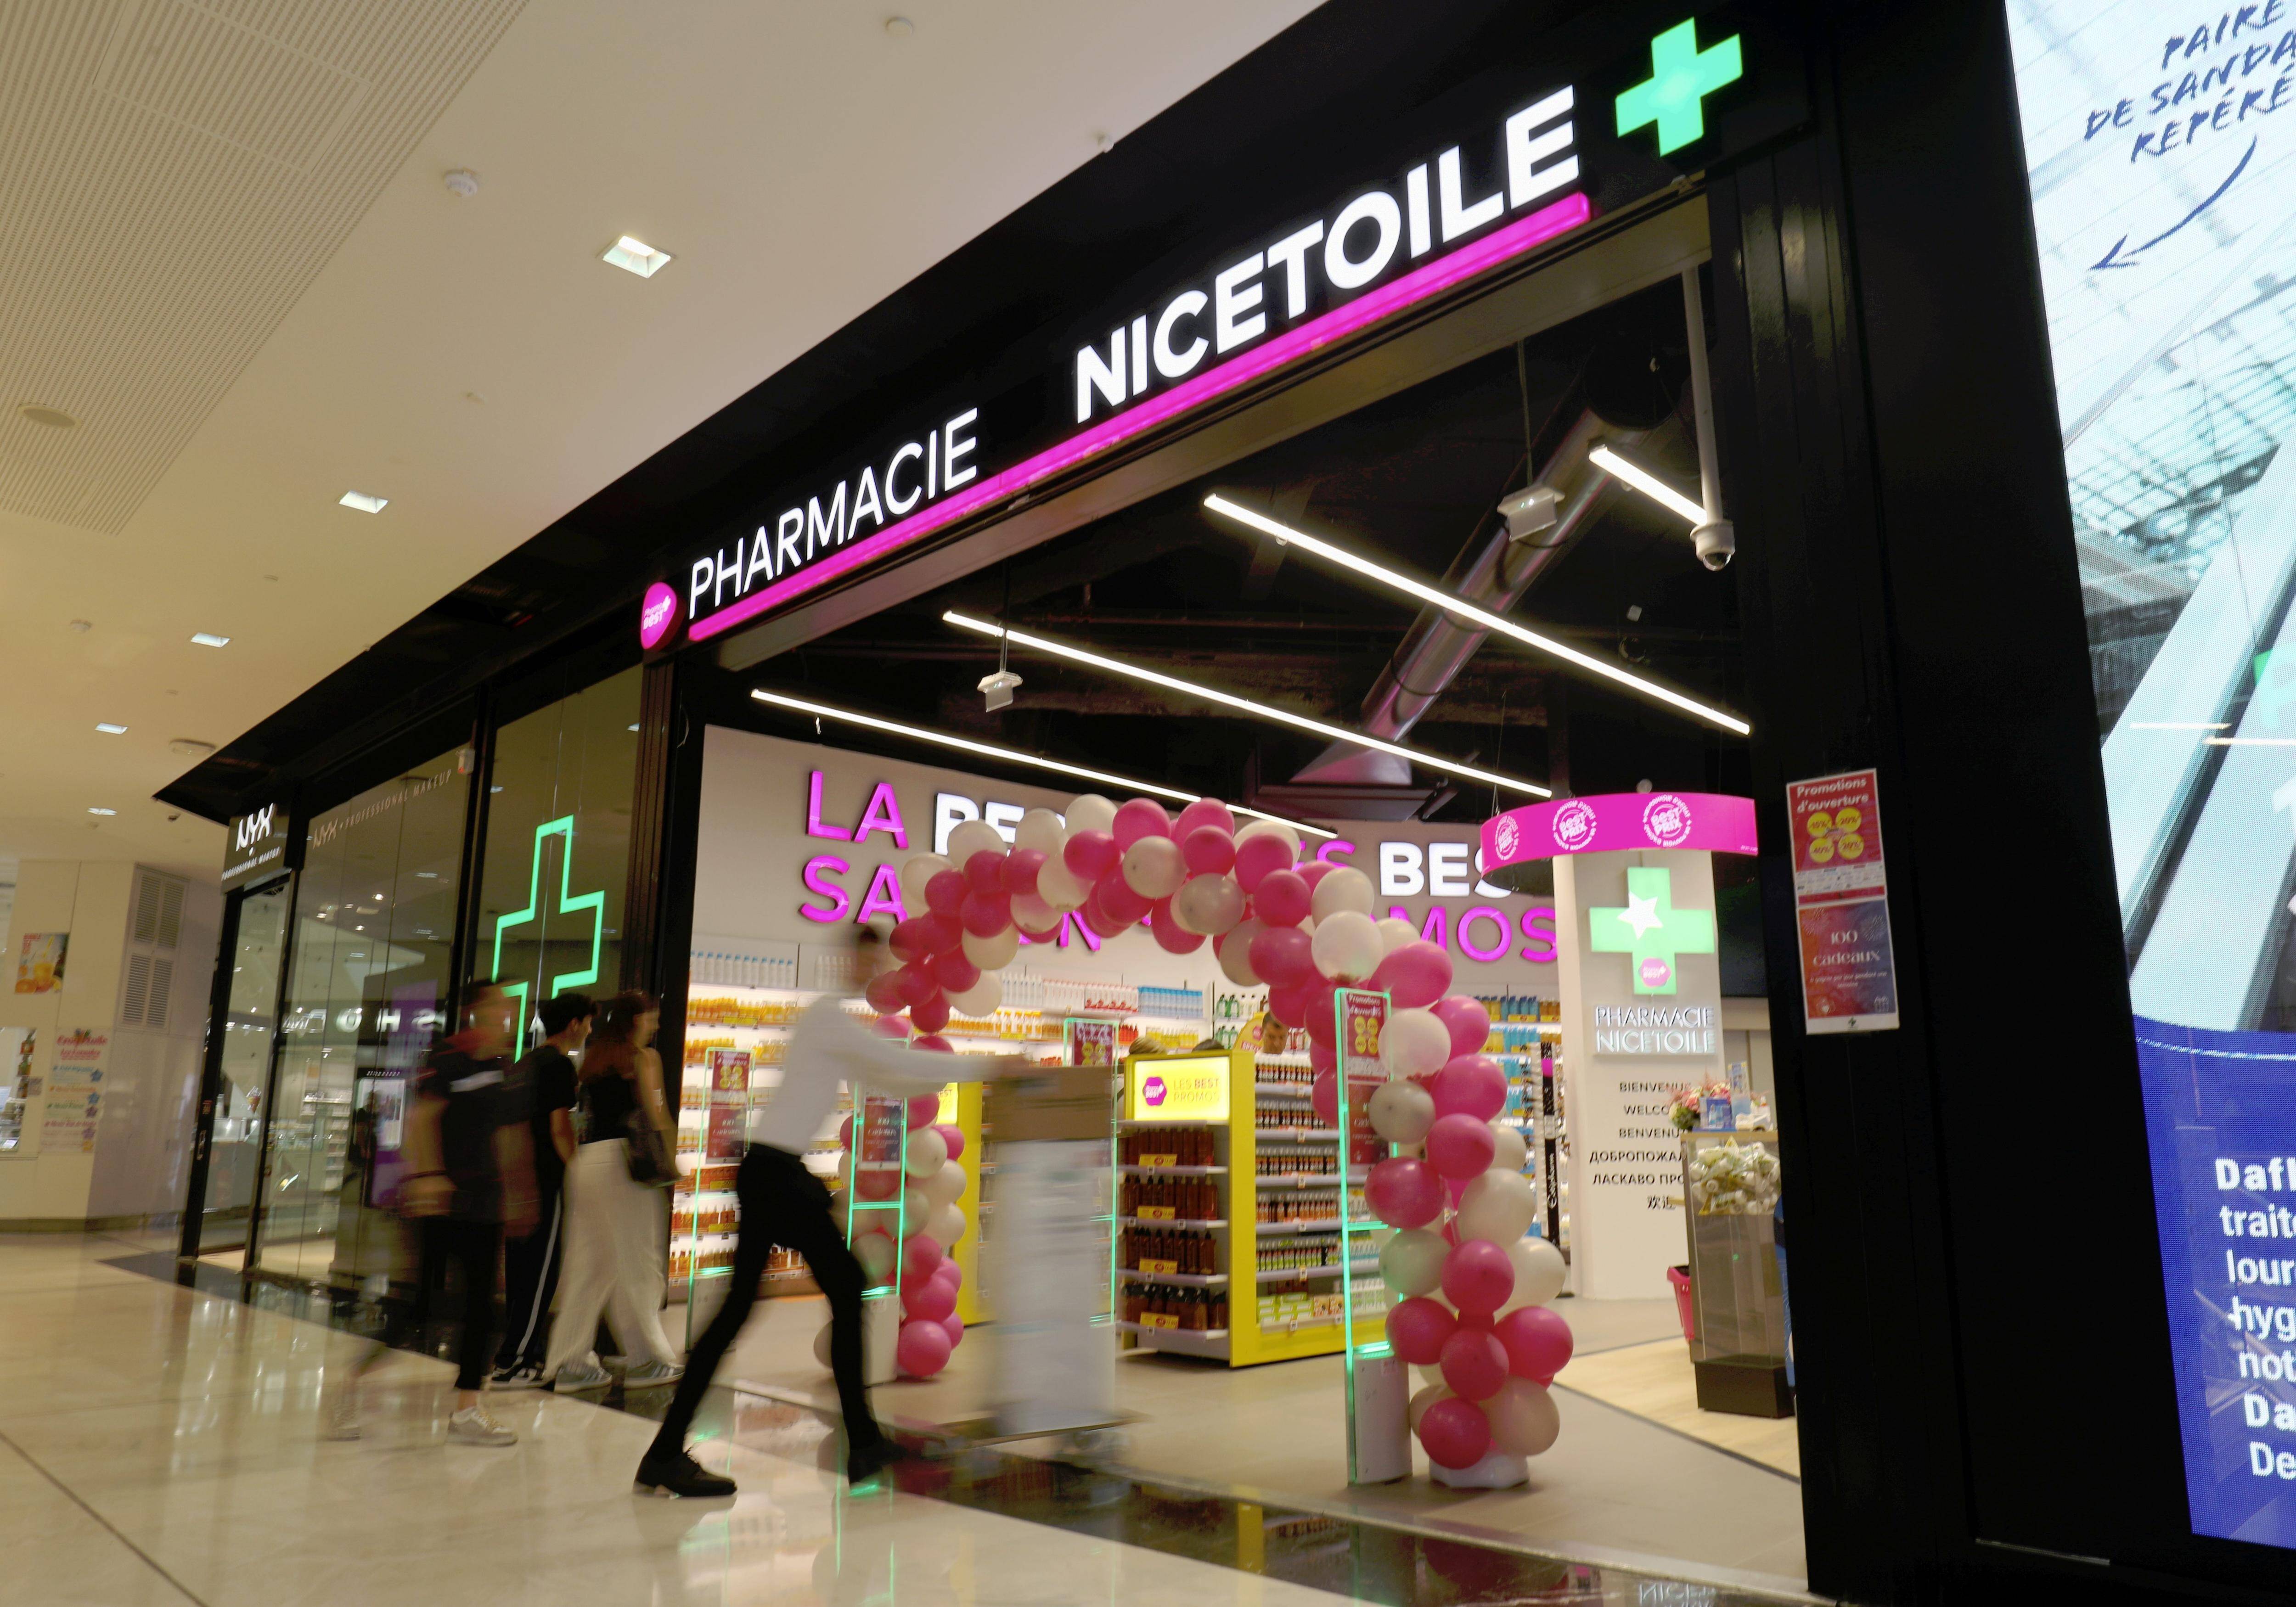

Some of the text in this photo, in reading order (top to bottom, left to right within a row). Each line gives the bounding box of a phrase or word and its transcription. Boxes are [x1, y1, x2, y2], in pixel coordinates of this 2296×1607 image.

[2162, 0, 2285, 70] PAIRE
[2084, 97, 2134, 141] DE
[689, 84, 1580, 620] PHARMACIE NICETOILE
[1796, 777, 1867, 798] Promotions
[313, 769, 452, 849] NYX PROFESSIONAL MAKEUP
[806, 770, 910, 849] LA
[1796, 793, 1869, 814] d'ouverture
[235, 803, 276, 852] NYX
[1650, 806, 1680, 827] BEST
[1831, 929, 1858, 945] 100
[1812, 950, 1881, 966] cadeaux
[1595, 1006, 1715, 1028] PHARMACIE
[1596, 1030, 1716, 1053] NICETOILE
[1195, 1079, 1219, 1090] BEST
[1619, 1128, 1684, 1139] BENVENU
[1593, 1173, 1655, 1186] ЛАСКАВО
[2219, 1202, 2296, 1239] trait
[2226, 1249, 2296, 1286] lour
